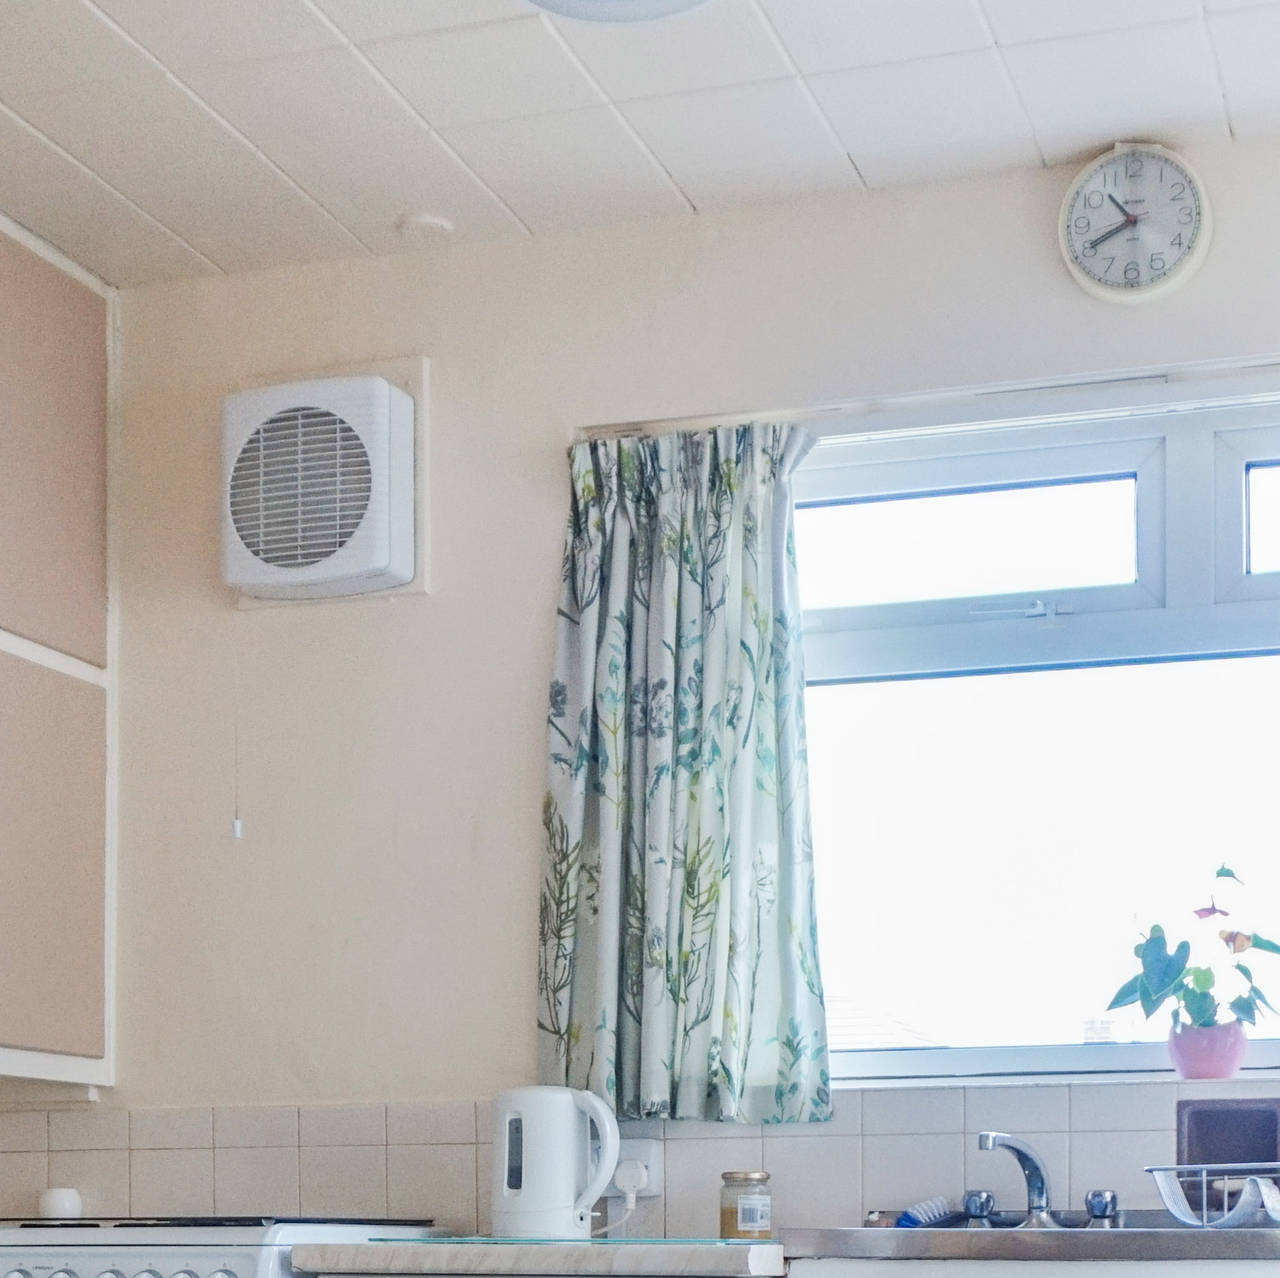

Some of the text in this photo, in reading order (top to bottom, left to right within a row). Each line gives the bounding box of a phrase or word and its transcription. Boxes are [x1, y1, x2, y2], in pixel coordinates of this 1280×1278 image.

[1125, 159, 1144, 179] 12
[1103, 170, 1117, 188] 11
[1083, 190, 1104, 209] 10
[1170, 182, 1185, 201] 2
[1074, 216, 1090, 235] 9
[1177, 207, 1193, 225] 3
[1082, 239, 1097, 258] 8
[1170, 232, 1183, 249] 4
[1103, 256, 1116, 274] 7
[1150, 251, 1166, 271] 5
[1124, 261, 1140, 281] 6
